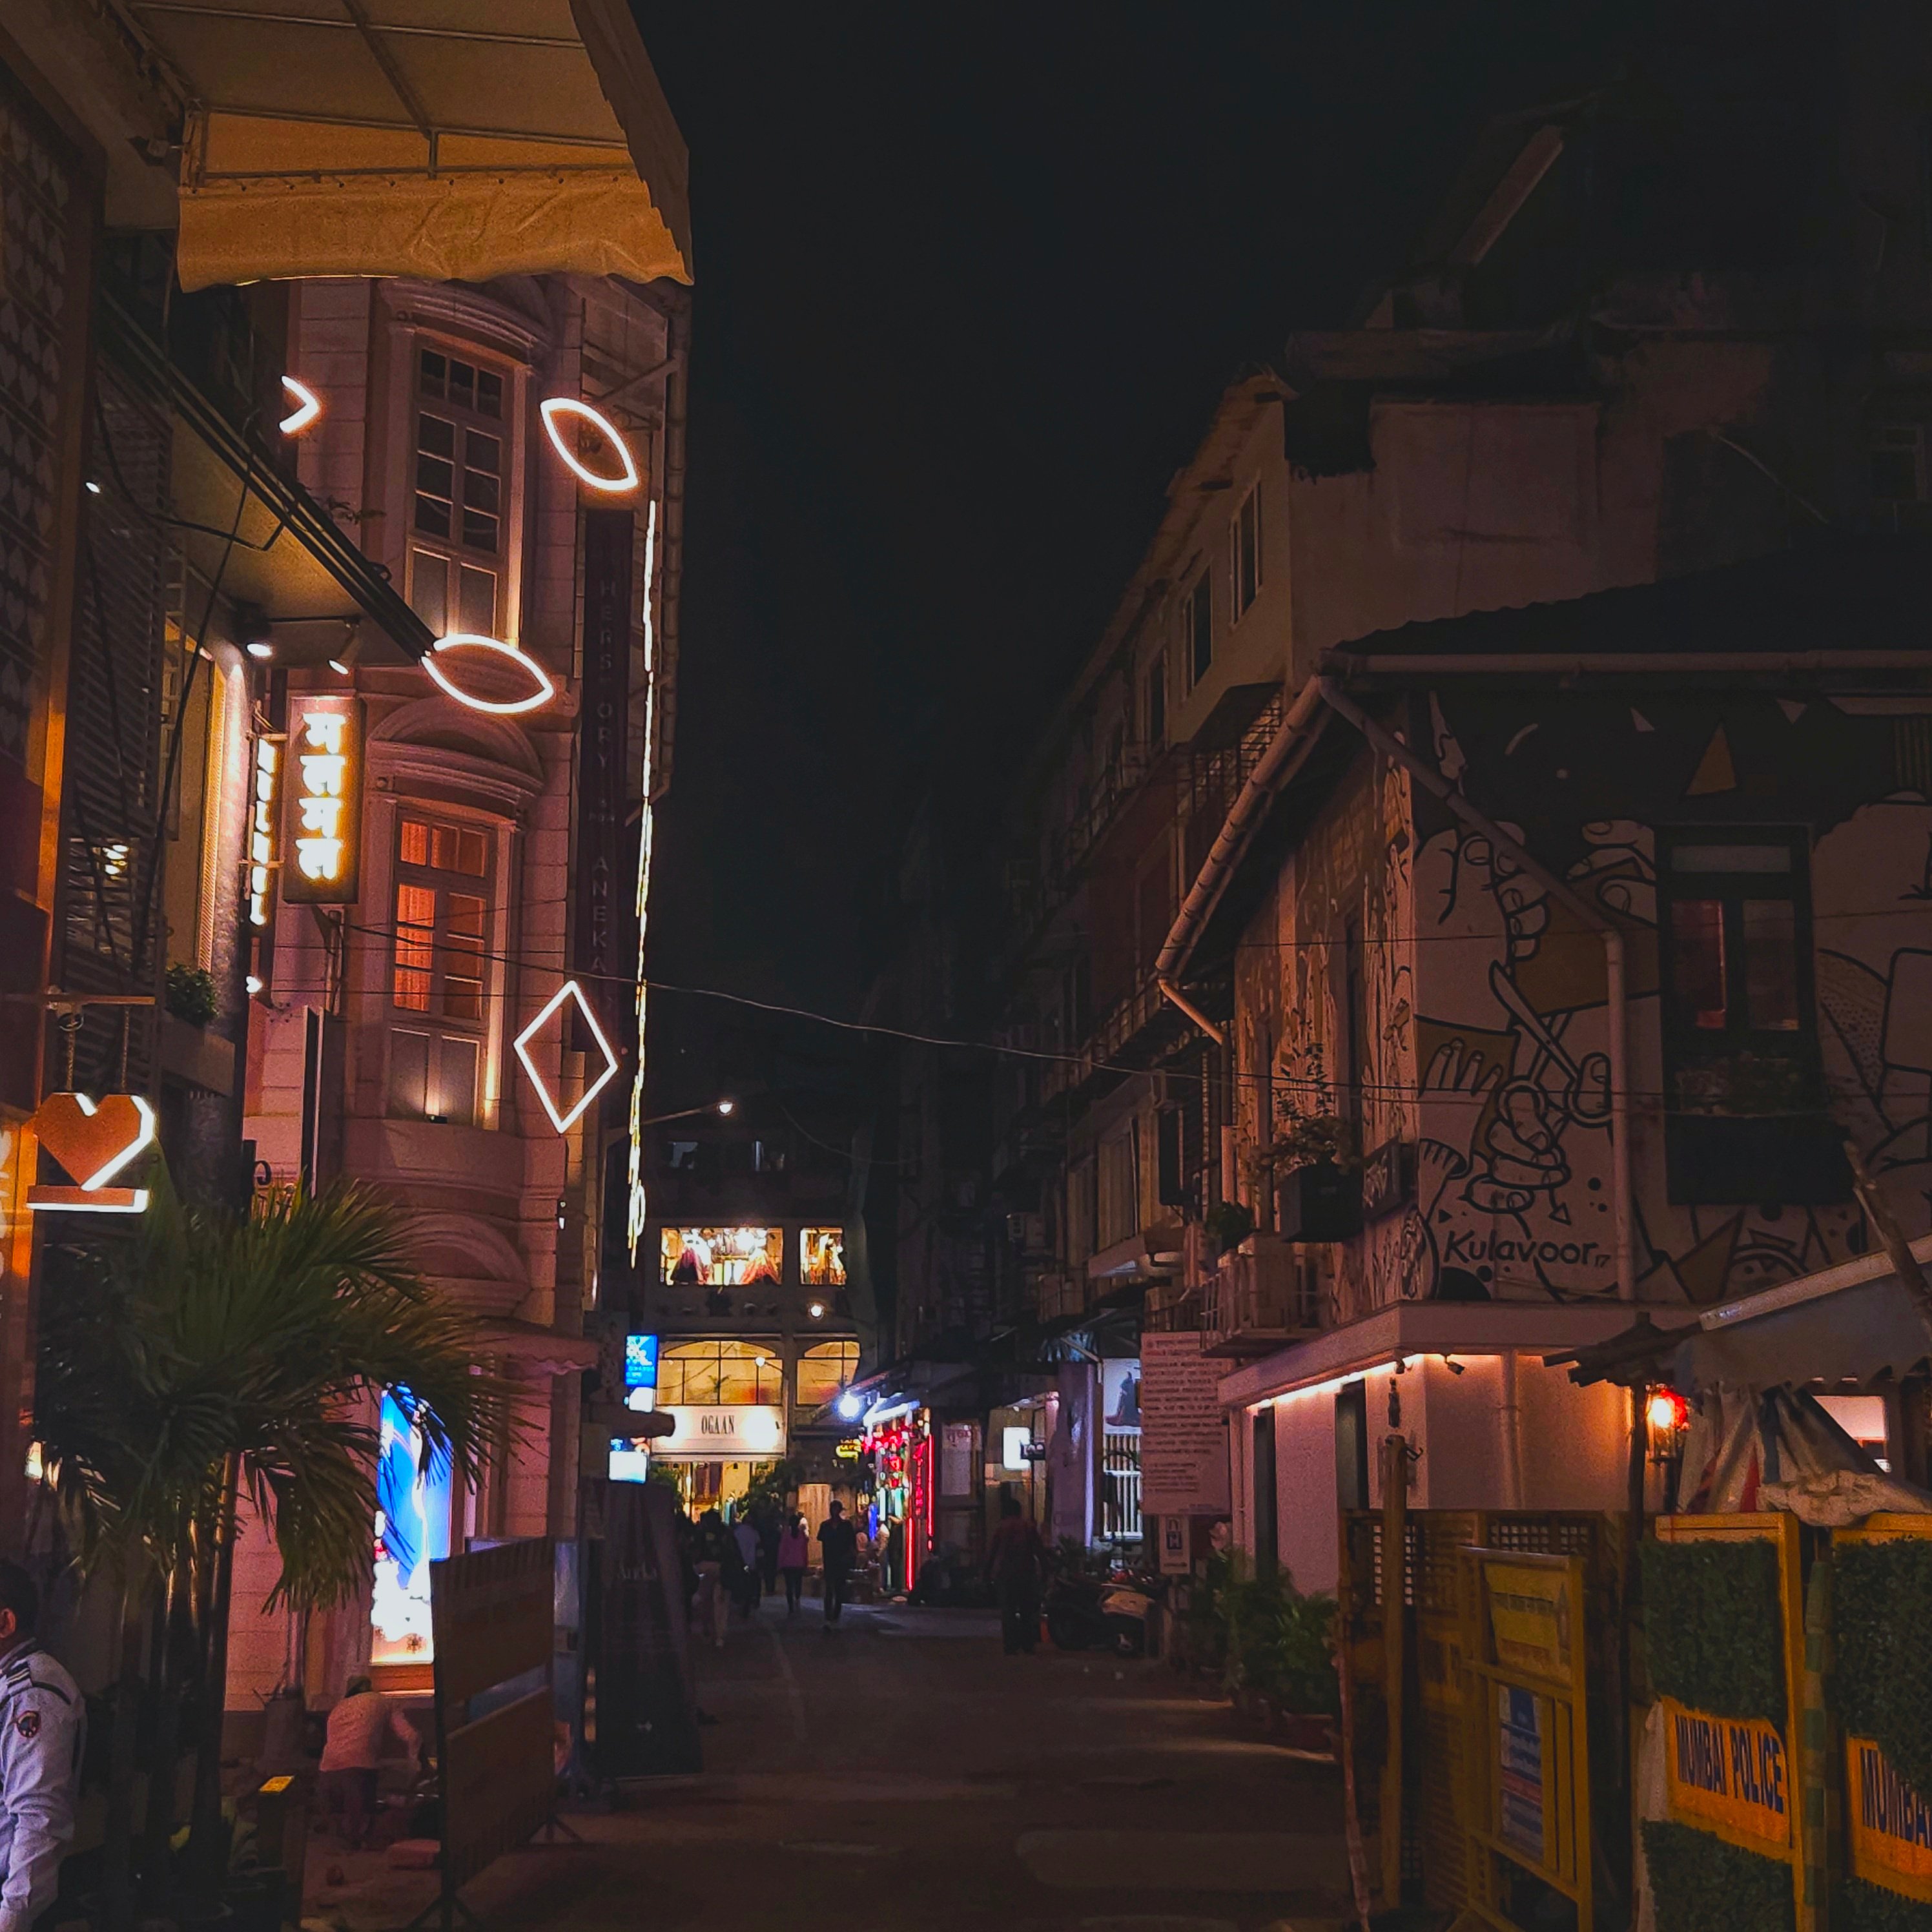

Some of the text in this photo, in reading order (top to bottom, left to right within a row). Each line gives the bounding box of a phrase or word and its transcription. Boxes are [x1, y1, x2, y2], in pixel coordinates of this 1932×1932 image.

[590, 856, 609, 973] ANEKA
[1443, 1229, 1598, 1264] Kulavoor
[701, 1415, 735, 1434] OGAAN
[1675, 1714, 1784, 1814] MUMBAI POLICE
